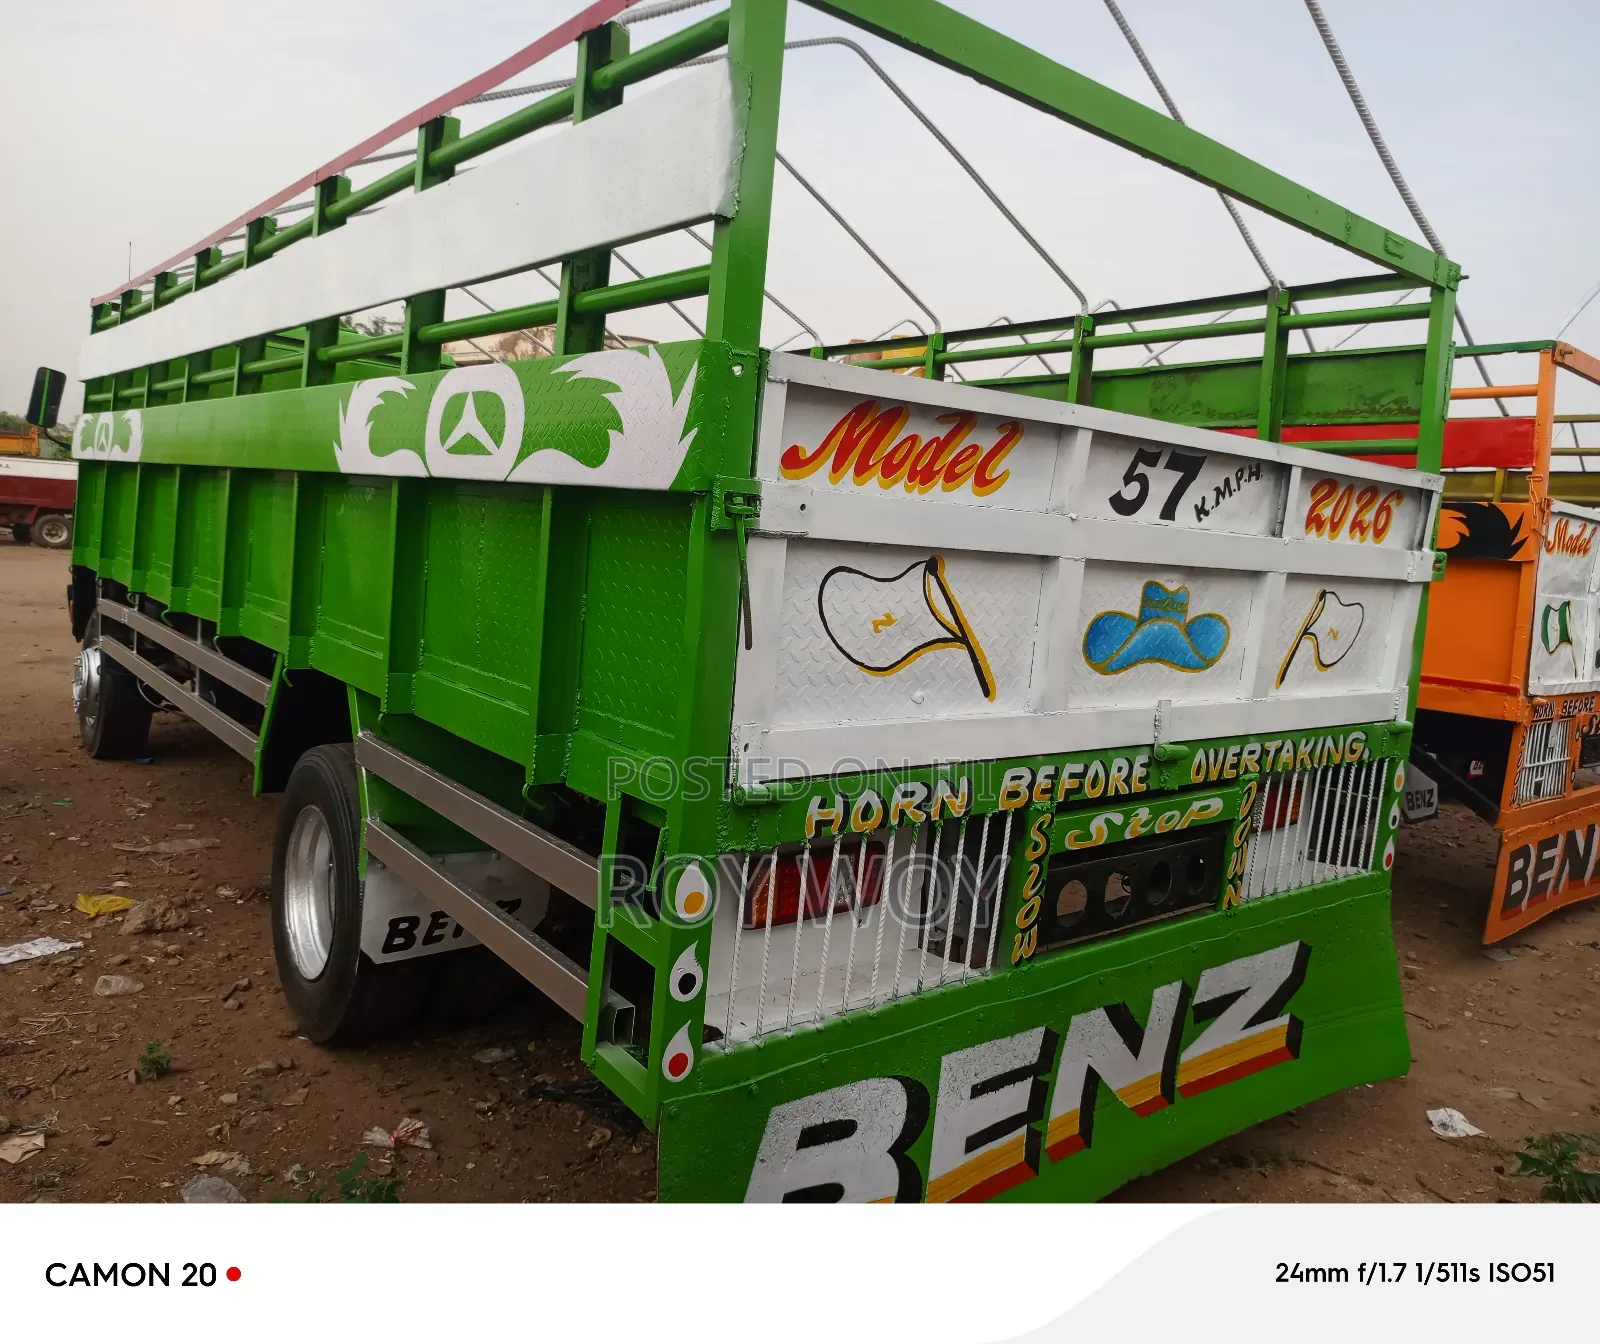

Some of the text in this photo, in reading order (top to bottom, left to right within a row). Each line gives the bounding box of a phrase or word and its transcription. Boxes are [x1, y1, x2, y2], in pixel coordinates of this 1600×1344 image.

[779, 399, 1025, 498] Model
[1108, 447, 1208, 522] 57
[1304, 477, 1404, 545] 2026
[1545, 516, 1598, 558] Model
[1562, 695, 1597, 716] BEFORE
[804, 775, 970, 838] HORN
[1000, 755, 1153, 811] BEFORE
[1405, 788, 1434, 812] BENZ
[1500, 823, 1600, 921] BEN
[742, 940, 1311, 1204] BENZ
